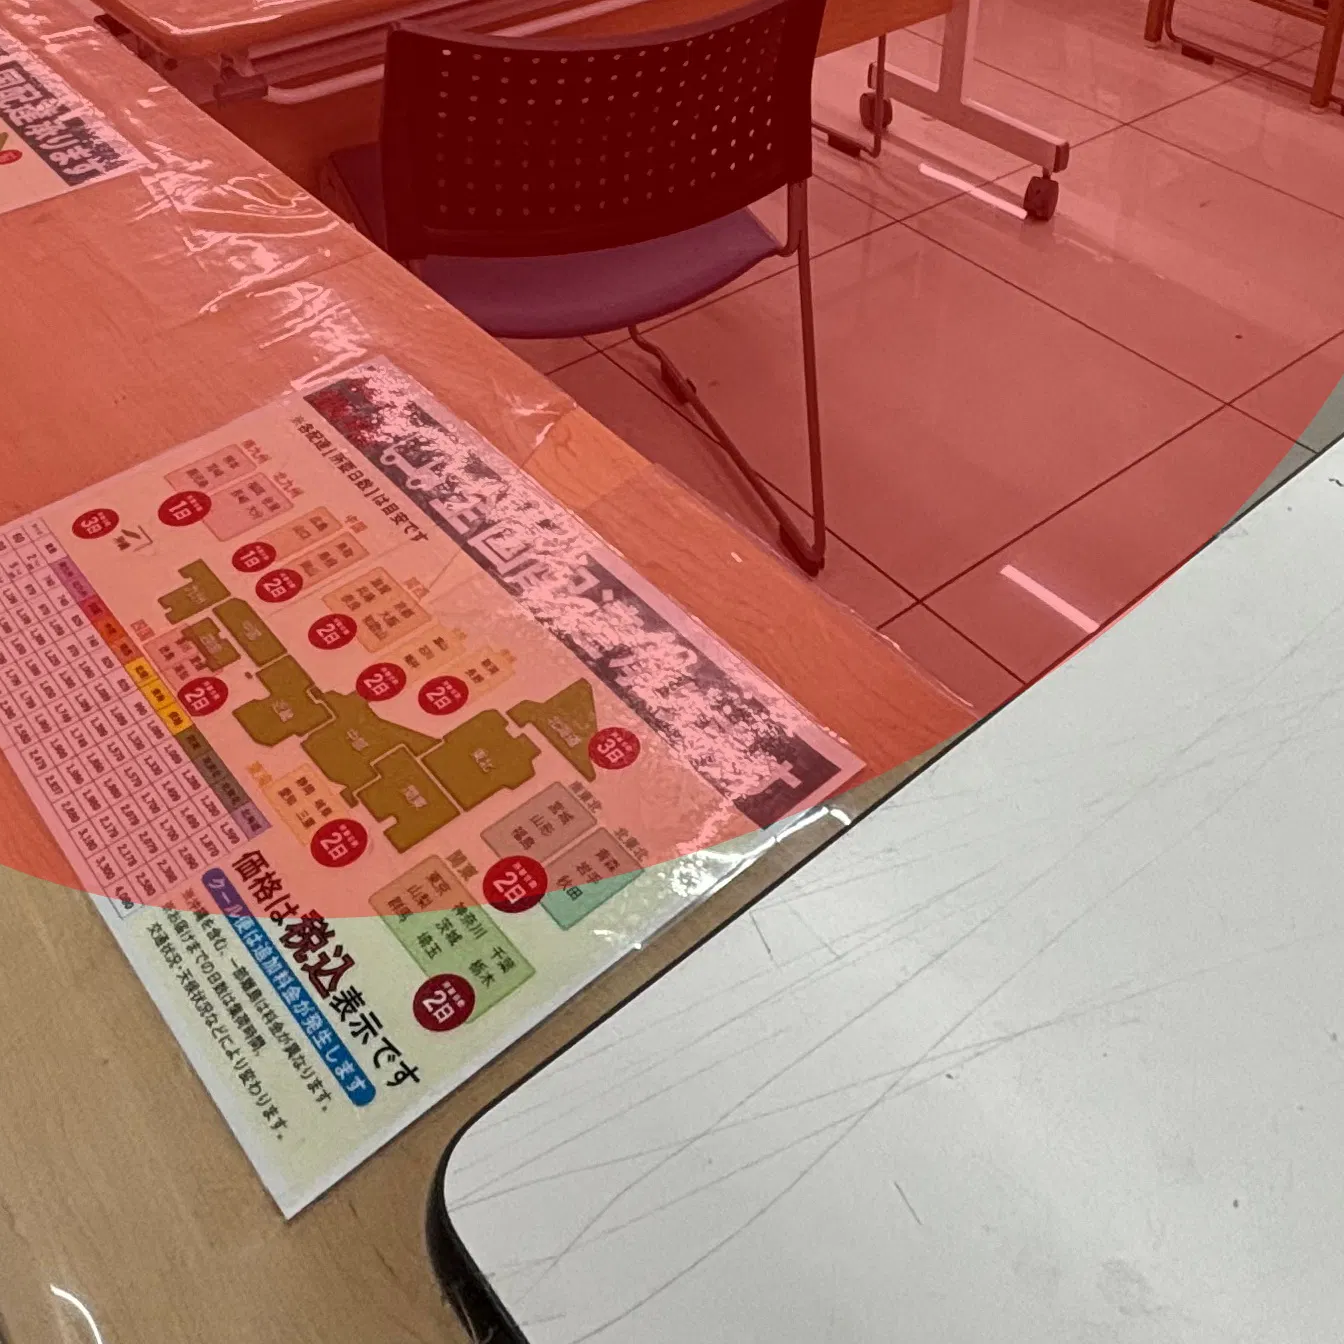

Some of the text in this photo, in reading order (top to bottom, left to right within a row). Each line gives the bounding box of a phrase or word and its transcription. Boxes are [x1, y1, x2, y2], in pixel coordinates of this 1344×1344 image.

[182, 684, 215, 712] 2日
[317, 829, 353, 863] 2日
[490, 871, 528, 907] 2日
[553, 872, 585, 903] 秋田
[423, 868, 517, 976] 東京 神奈川 千葉
[412, 929, 443, 961] 埼玉
[431, 915, 463, 948] 茨城
[465, 957, 497, 991] 栃木
[202, 872, 371, 1102] クール便は追加料金が発生します
[224, 838, 438, 1104] 価格は税込表示です
[419, 987, 458, 1026] 2日
